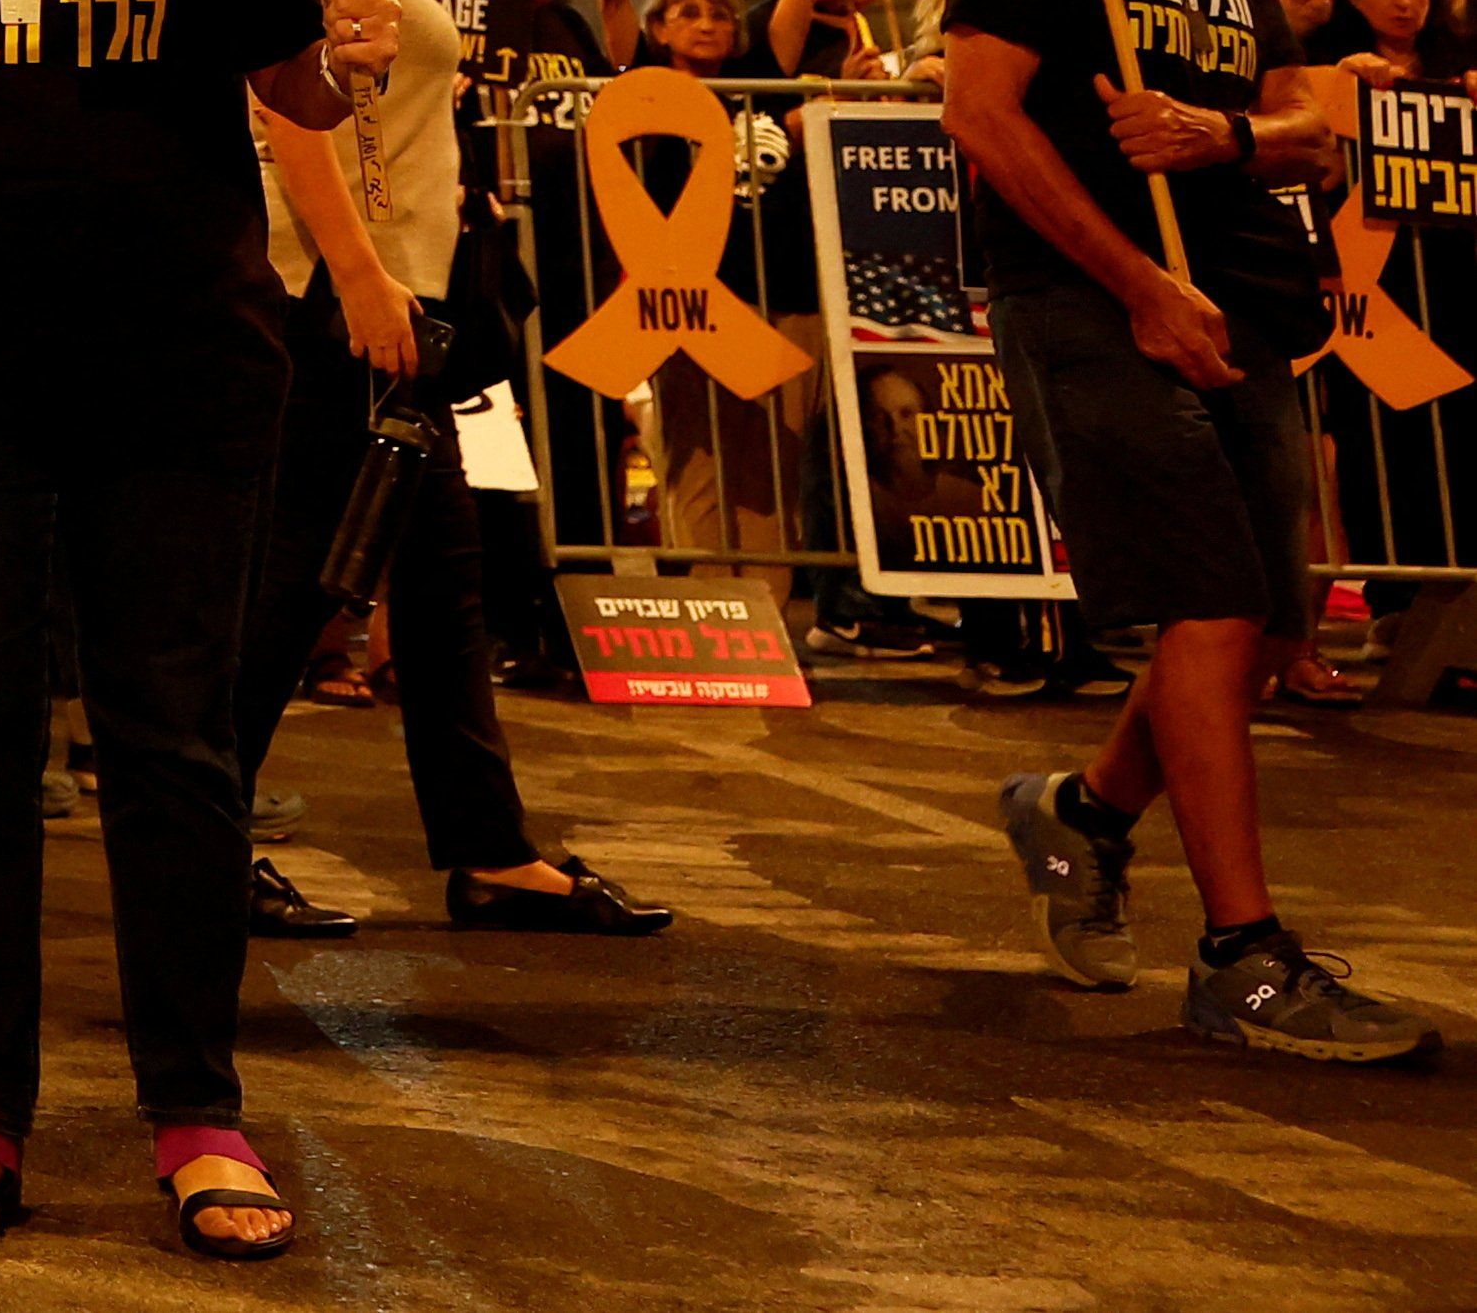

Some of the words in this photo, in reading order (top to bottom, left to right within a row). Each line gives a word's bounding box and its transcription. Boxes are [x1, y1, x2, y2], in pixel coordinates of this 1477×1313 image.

[842, 146, 911, 171] FREE
[872, 187, 958, 212] FROM
[638, 286, 718, 334] NOW.
[938, 362, 1010, 410] אמא
[916, 410, 1013, 461] לעולם
[981, 463, 1020, 513] לא
[910, 515, 1032, 565] מוותרת
[594, 597, 680, 618] שבויים
[684, 599, 748, 622] פדיון
[581, 626, 695, 658] מחיר
[698, 623, 786, 660] בכל
